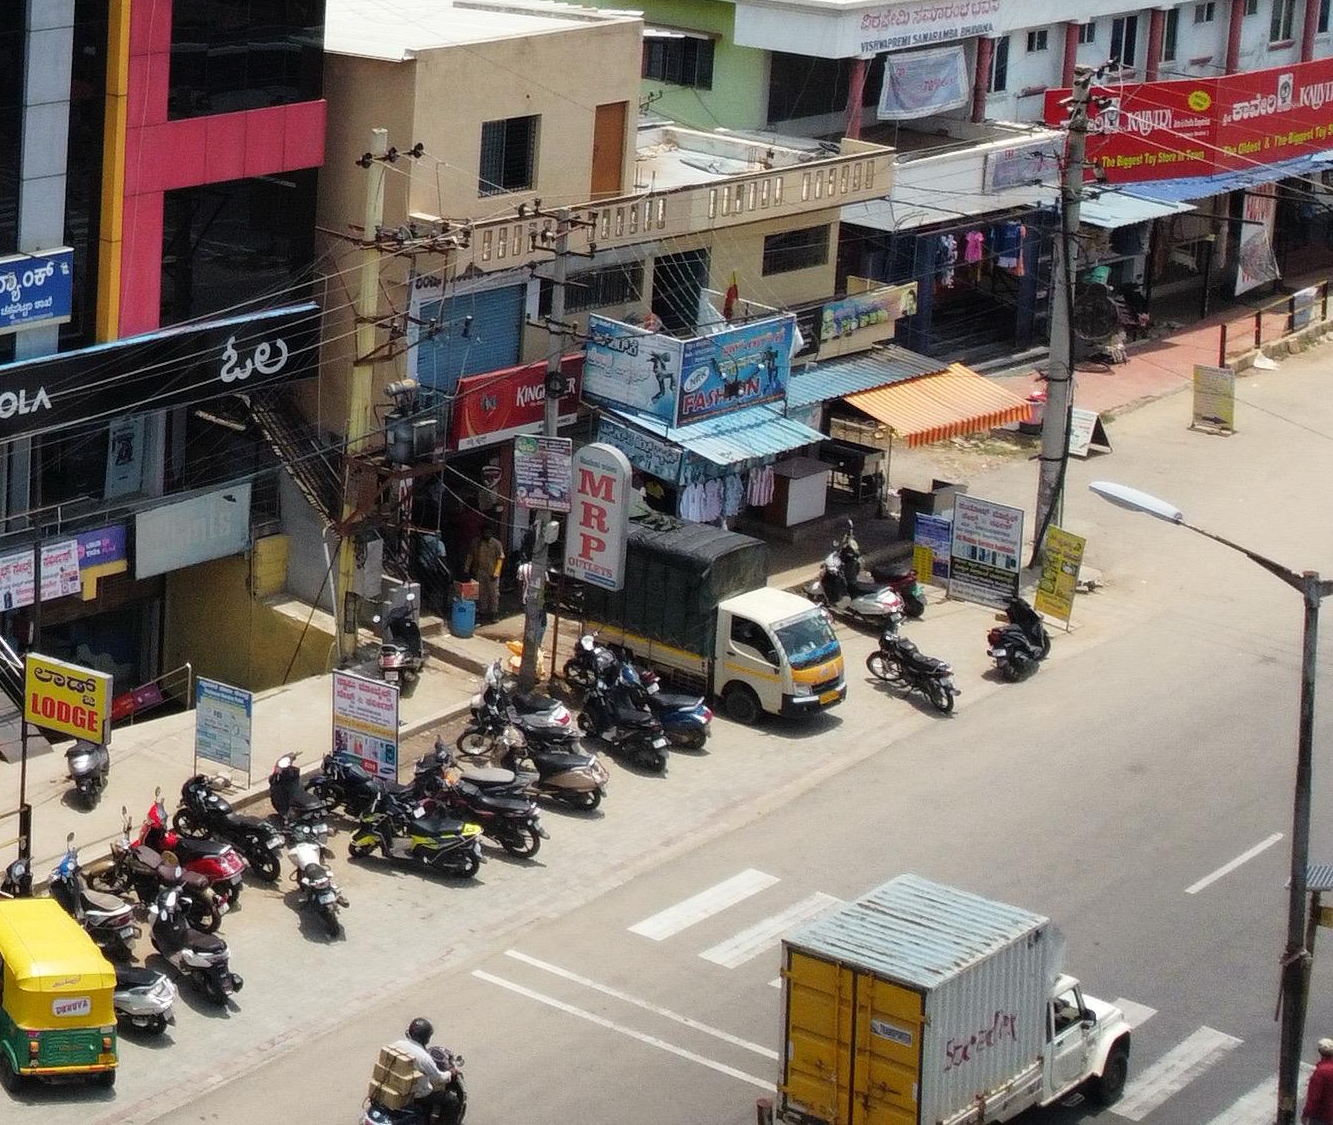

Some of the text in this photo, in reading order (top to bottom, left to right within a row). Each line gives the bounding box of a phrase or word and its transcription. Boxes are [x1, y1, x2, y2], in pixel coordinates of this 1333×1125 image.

[516, 377, 576, 408] KINGER
[683, 376, 761, 415] FASHN
[568, 556, 614, 578] OUTLETS
[31, 692, 99, 732] LODGE
